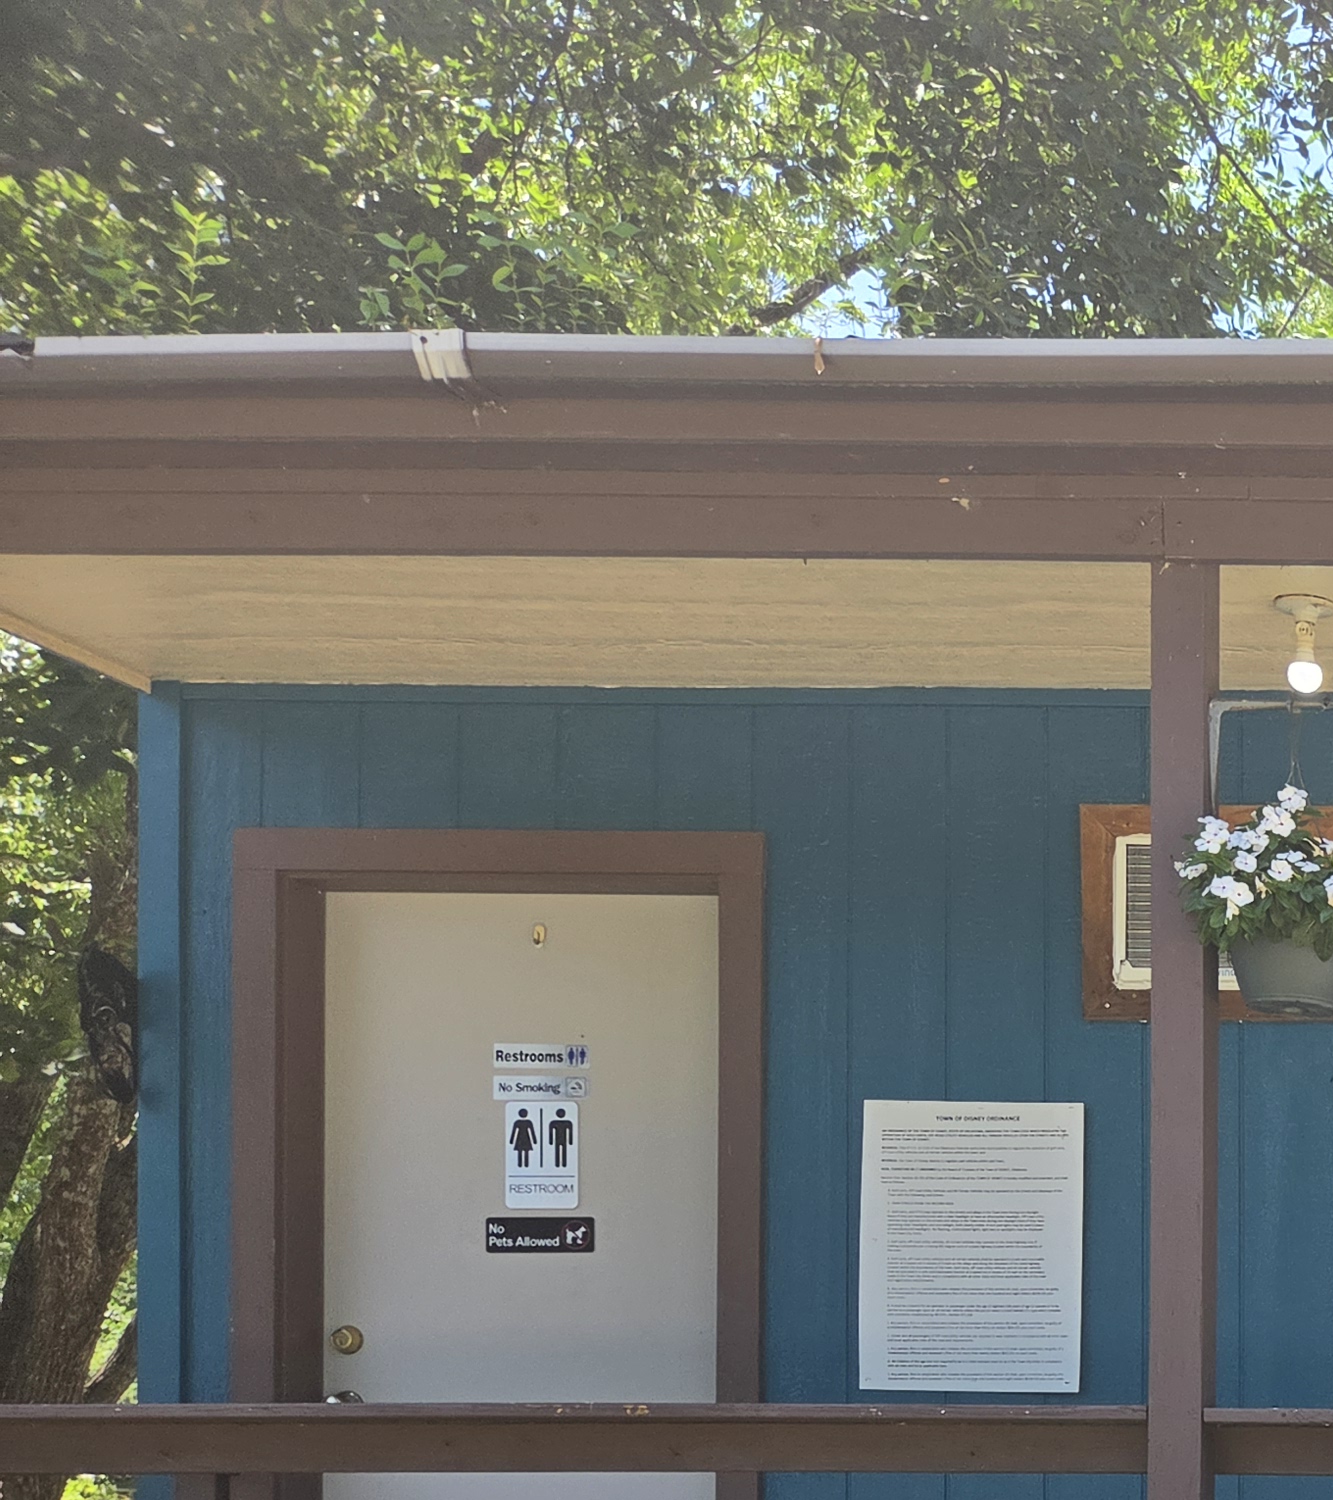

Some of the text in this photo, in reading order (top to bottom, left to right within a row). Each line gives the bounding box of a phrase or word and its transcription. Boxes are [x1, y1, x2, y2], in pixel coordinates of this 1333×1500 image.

[495, 1050, 564, 1063] Restrooms
[498, 1082, 561, 1095] No Smoking
[509, 1184, 574, 1194] RESTROOM
[488, 1223, 505, 1234] No
[488, 1236, 560, 1247] Pets Allowed
